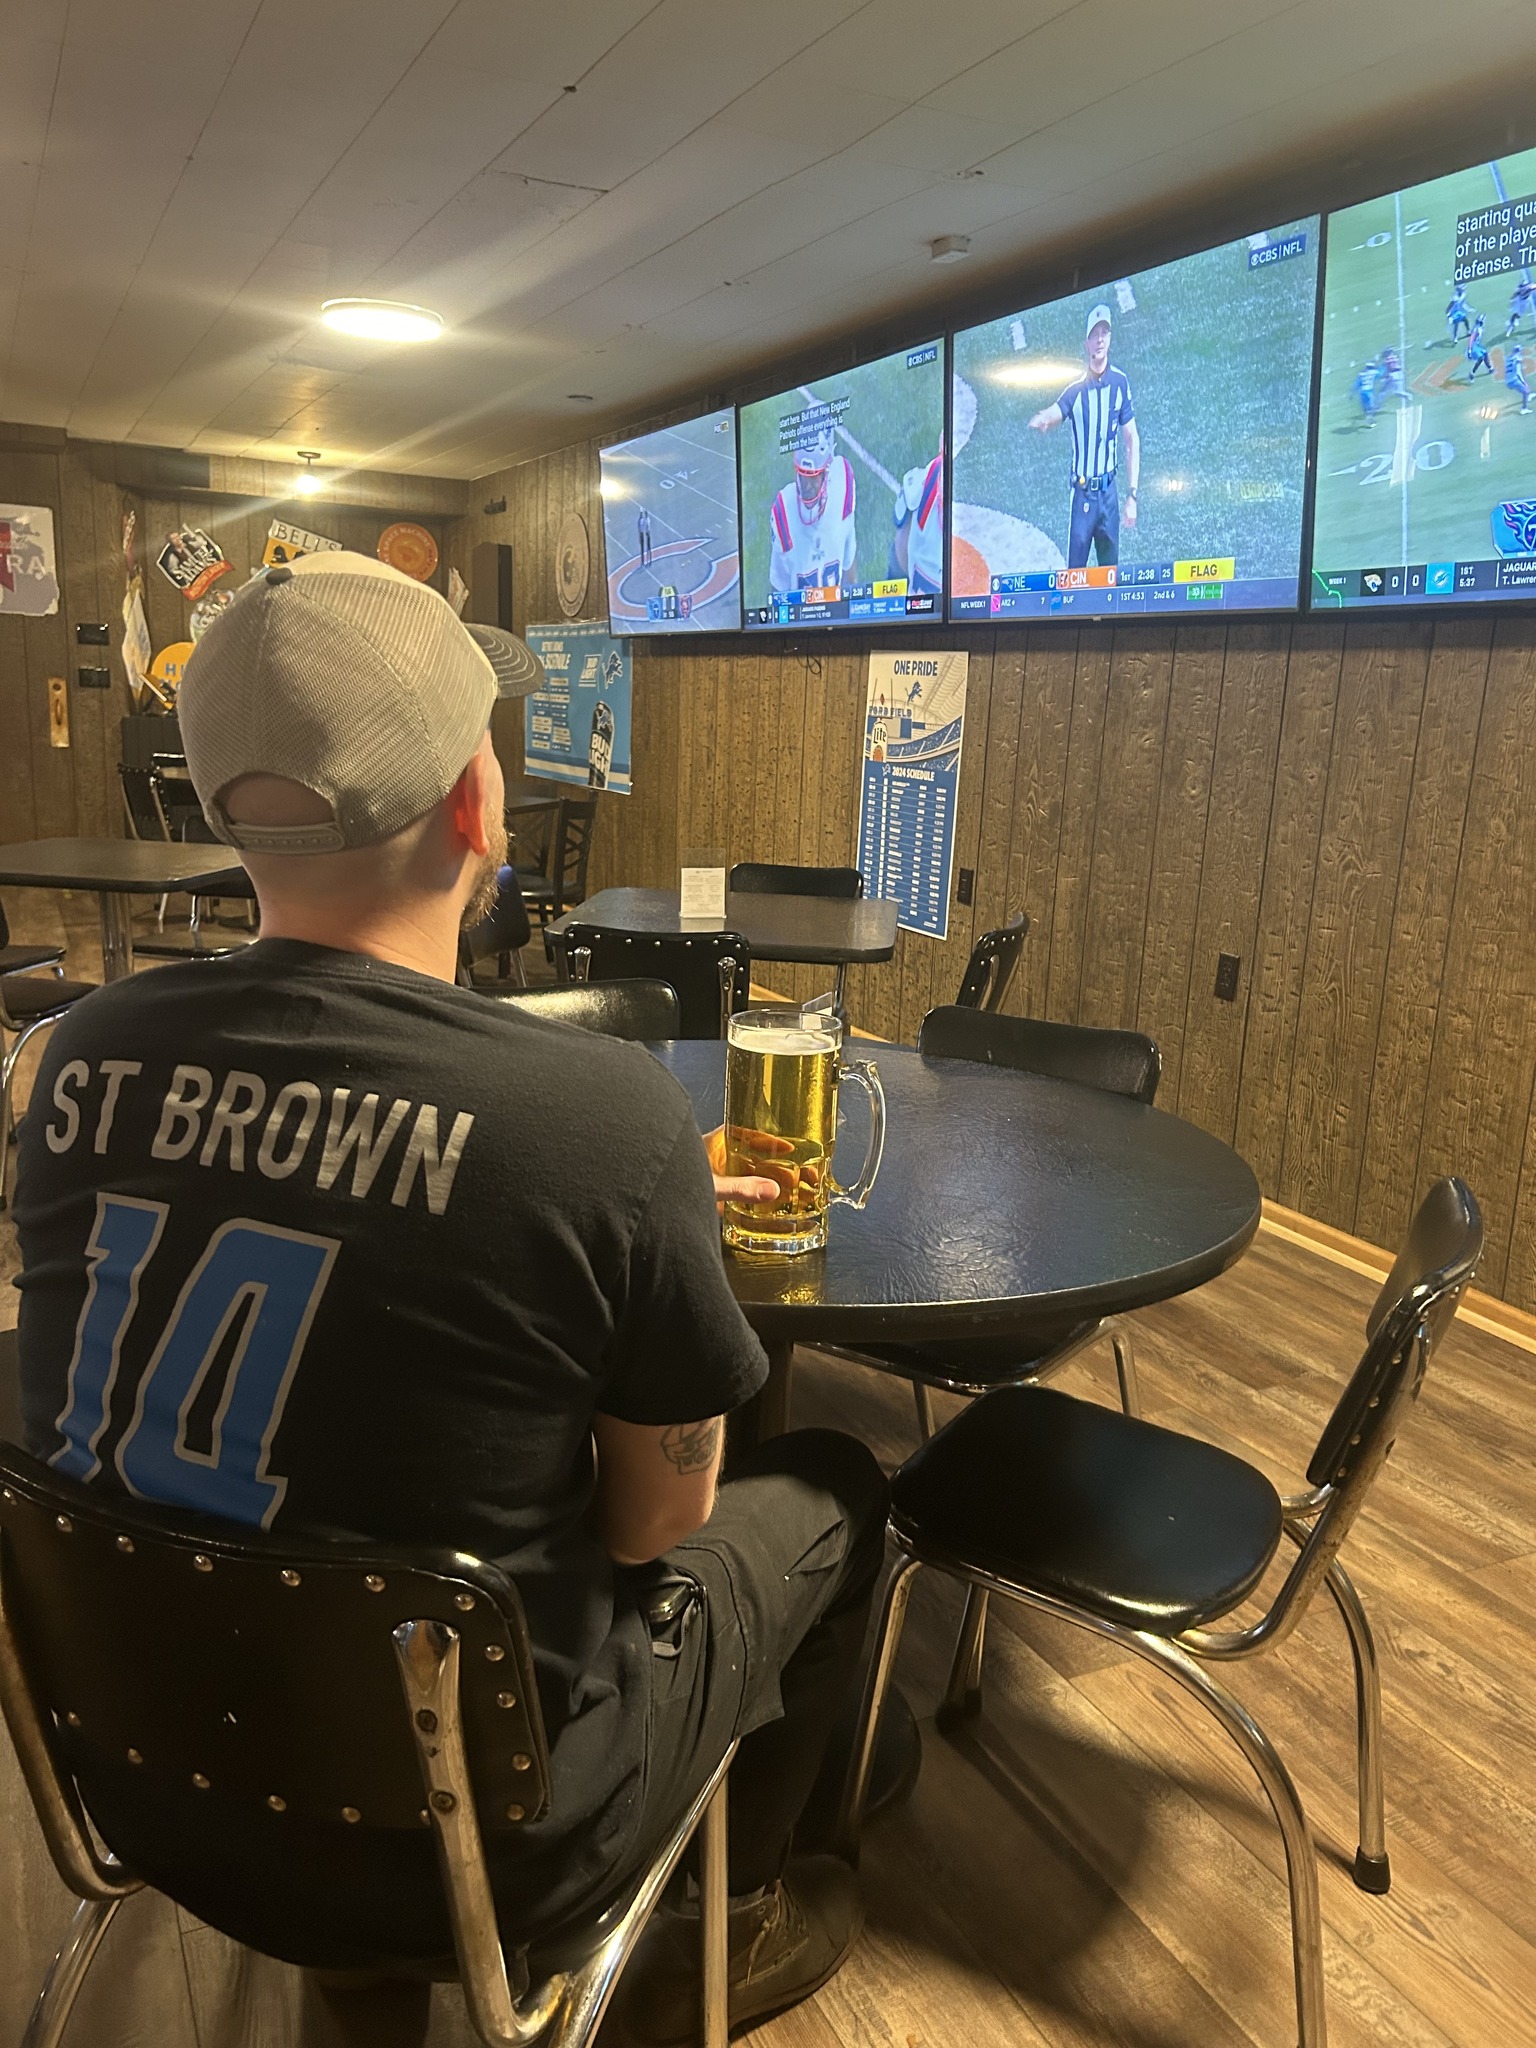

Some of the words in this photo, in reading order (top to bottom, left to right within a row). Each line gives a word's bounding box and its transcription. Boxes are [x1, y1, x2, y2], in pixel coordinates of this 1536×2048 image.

[1457, 208, 1511, 234] starting
[1456, 238, 1471, 258] of
[1474, 235, 1496, 253] the
[1454, 256, 1514, 281] defense.
[780, 417, 790, 429] start
[831, 397, 851, 414] England
[780, 429, 796, 440] Patriots
[814, 416, 838, 432] everything
[838, 414, 844, 424] is
[789, 440, 800, 451] from
[800, 437, 808, 447] the
[0, 553, 47, 575] RA
[1137, 568, 1155, 580] 2:38
[1162, 568, 1171, 578] 25
[1190, 564, 1217, 577] FLAG
[1460, 566, 1474, 575] 1ST
[1014, 576, 1026, 588] NE
[1048, 575, 1055, 588] 0
[1070, 572, 1087, 585] CIN
[1107, 569, 1115, 585] 0
[1392, 575, 1399, 588] 0
[1412, 574, 1420, 587] 0
[882, 584, 898, 595] FLAG
[1120, 592, 1131, 601] 1ST
[1131, 591, 1145, 600] 4:53
[1153, 590, 1165, 600] 2nd
[1063, 596, 1074, 604] BUF
[894, 660, 911, 675] ONE
[911, 661, 938, 677] PRIDE
[873, 728, 887, 744] Lite
[892, 766, 907, 778] 2024
[906, 768, 935, 781] SCHEDULE
[45, 1060, 143, 1154] ST
[151, 1064, 475, 1216] BROWN
[47, 1191, 342, 1533] 14
